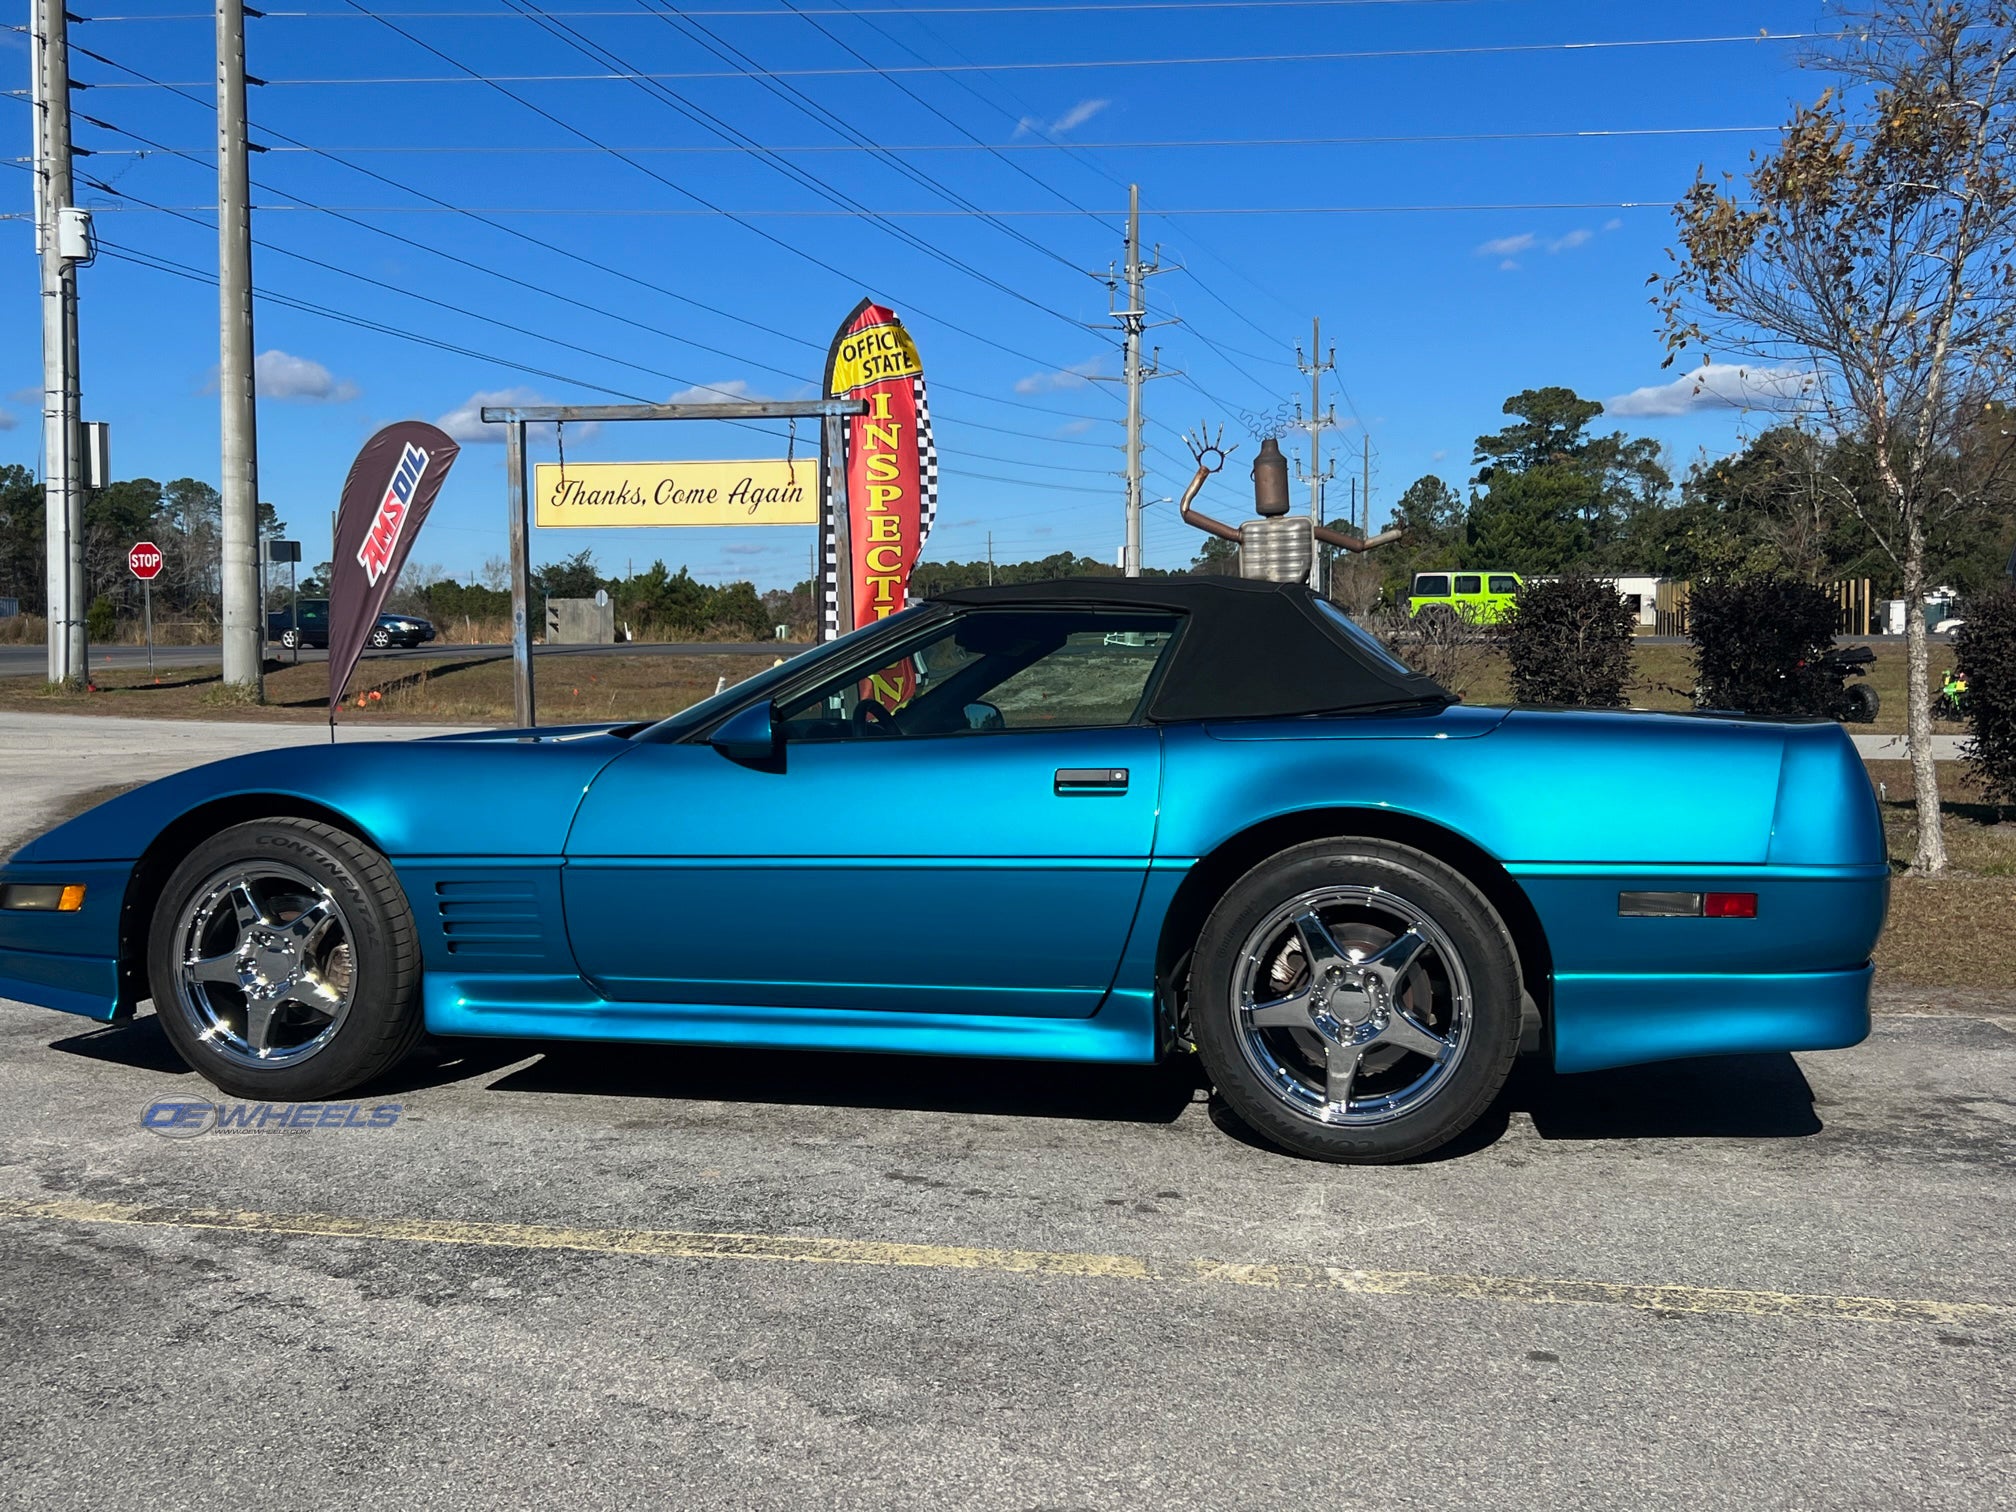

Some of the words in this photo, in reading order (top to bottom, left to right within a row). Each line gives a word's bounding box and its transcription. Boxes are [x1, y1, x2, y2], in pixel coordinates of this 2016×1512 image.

[843, 331, 903, 362] OFFICI
[862, 351, 914, 379] STATE
[358, 443, 429, 585] AMSOIL
[551, 478, 646, 507] Thanks,
[654, 478, 718, 505] Come
[728, 477, 803, 515] Again
[131, 553, 160, 568] STOP
[862, 393, 904, 704] INSPECTN
[255, 835, 380, 948] CONTINENTAL
